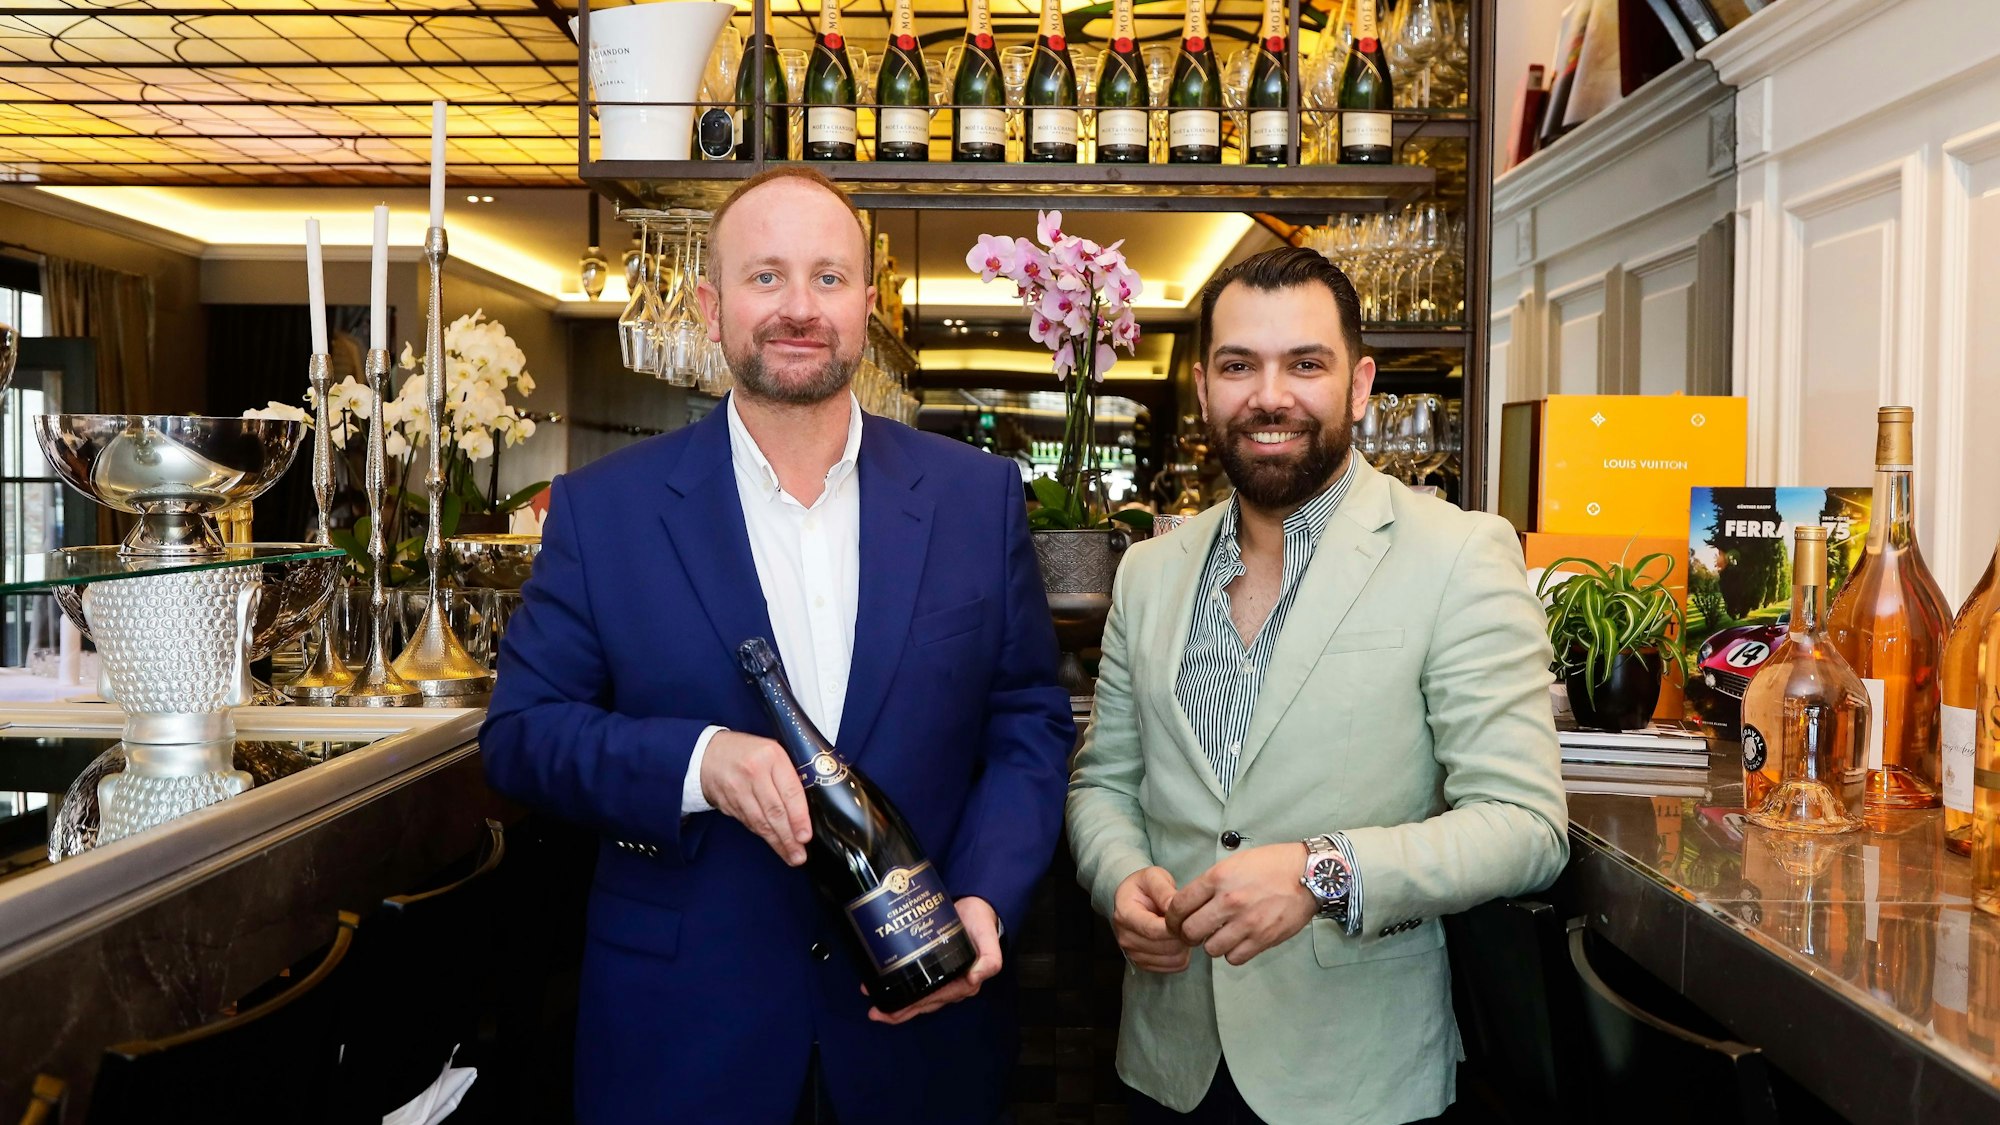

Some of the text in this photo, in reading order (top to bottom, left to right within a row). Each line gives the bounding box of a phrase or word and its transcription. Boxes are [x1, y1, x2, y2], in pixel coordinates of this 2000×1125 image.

[1603, 458, 1688, 470] LOUIS VUITTON
[1725, 519, 1850, 540] FERRA 75
[1729, 641, 1766, 666] 14
[875, 891, 945, 938] TAITTINGER
[886, 890, 931, 919] CHAMPAGNE
